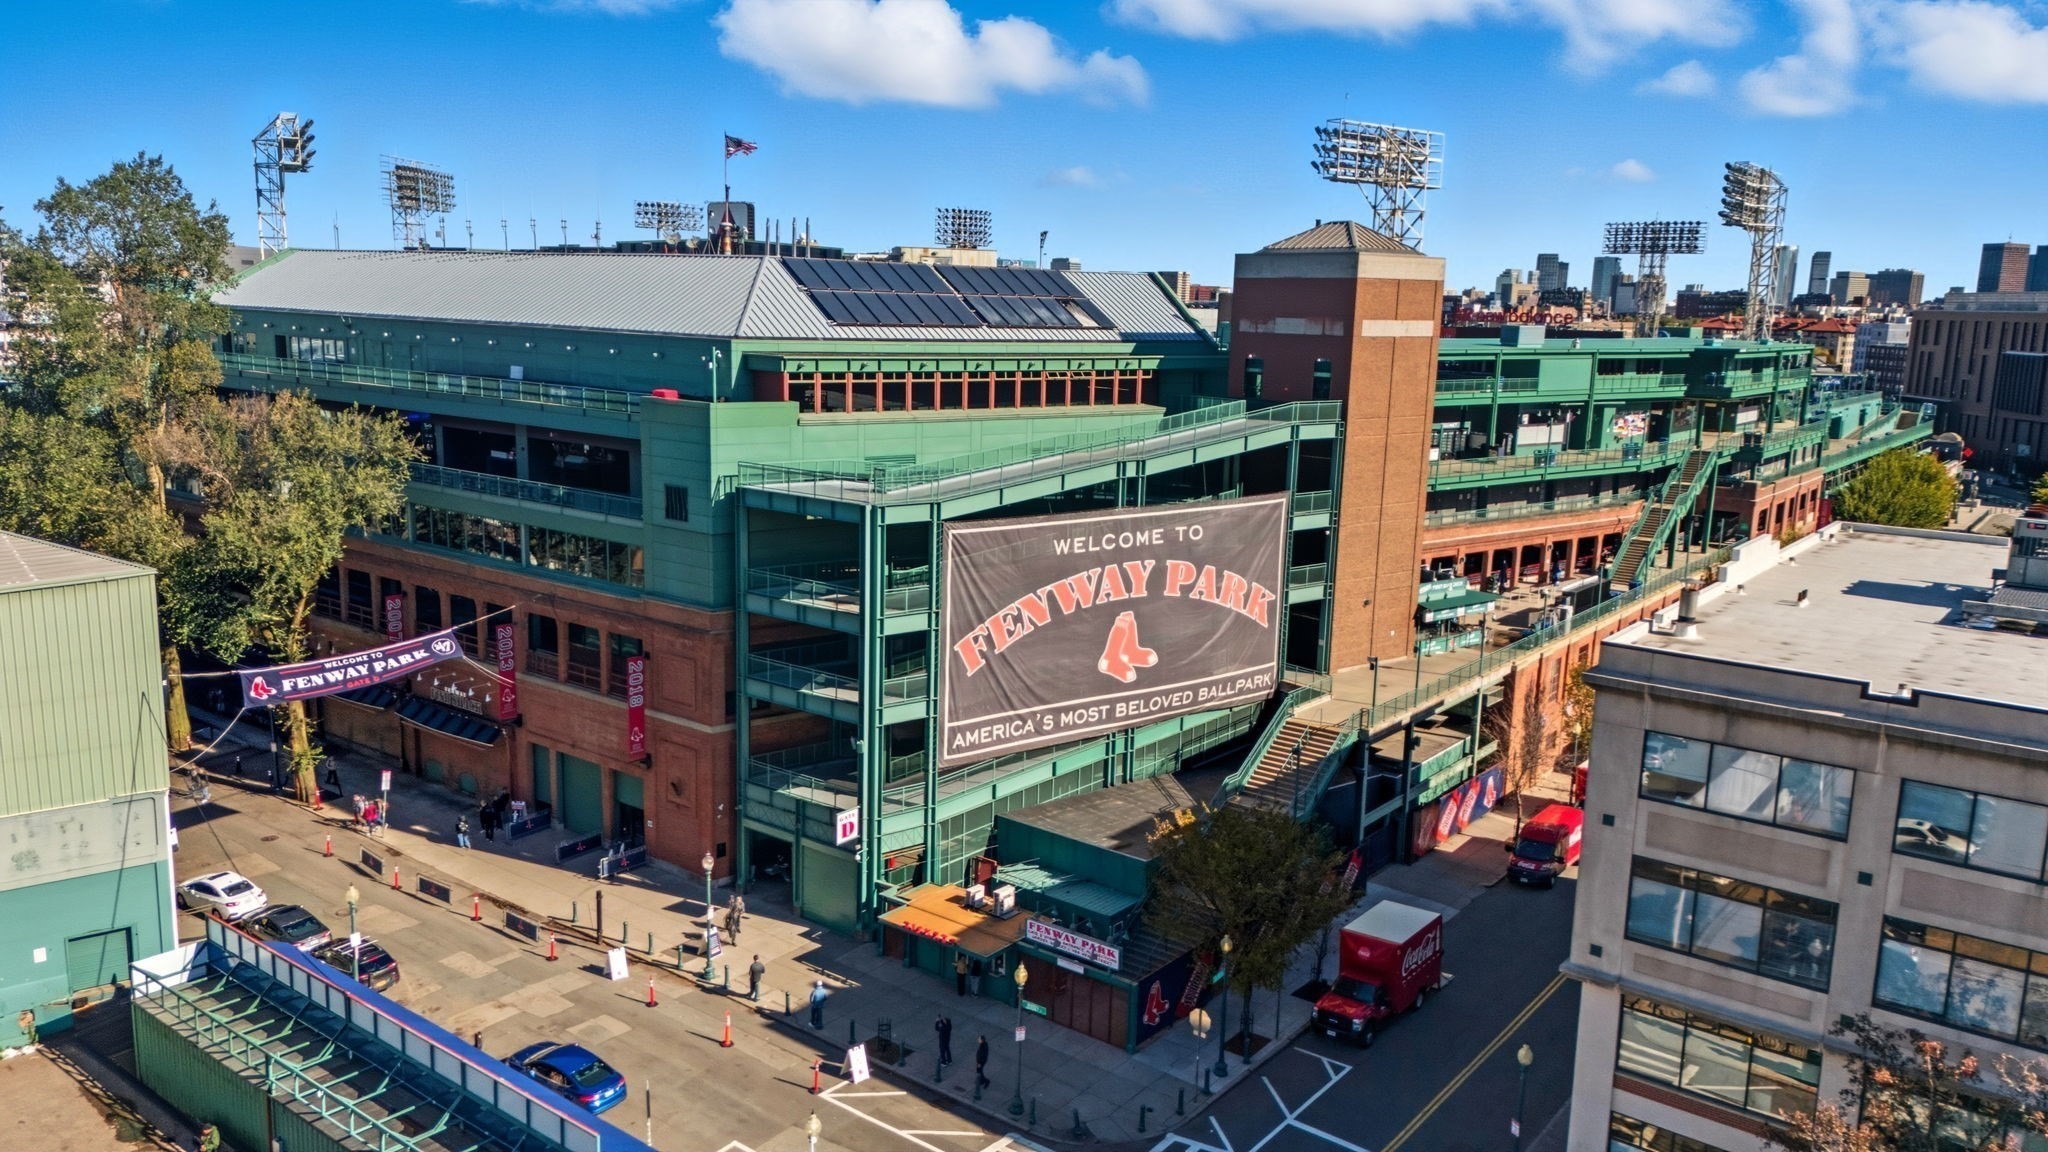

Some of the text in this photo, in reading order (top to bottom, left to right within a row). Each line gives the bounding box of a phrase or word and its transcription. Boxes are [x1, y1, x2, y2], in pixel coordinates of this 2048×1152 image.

[1053, 525, 1204, 556] WELCOME TO
[387, 598, 403, 642] 2007
[953, 559, 1276, 677] FENWAY PARK
[323, 651, 384, 670] WELCOME TO
[497, 624, 514, 672] 2013
[281, 662, 370, 693] FENWAY
[373, 648, 431, 673] PARK
[346, 677, 371, 690] GATE
[627, 659, 645, 708] 2018
[952, 671, 1273, 749] AMERICA'S MOST BELOVED BALLPARK
[841, 821, 856, 839] D
[1028, 921, 1079, 946] FENWAY
[1081, 937, 1117, 959] PARK
